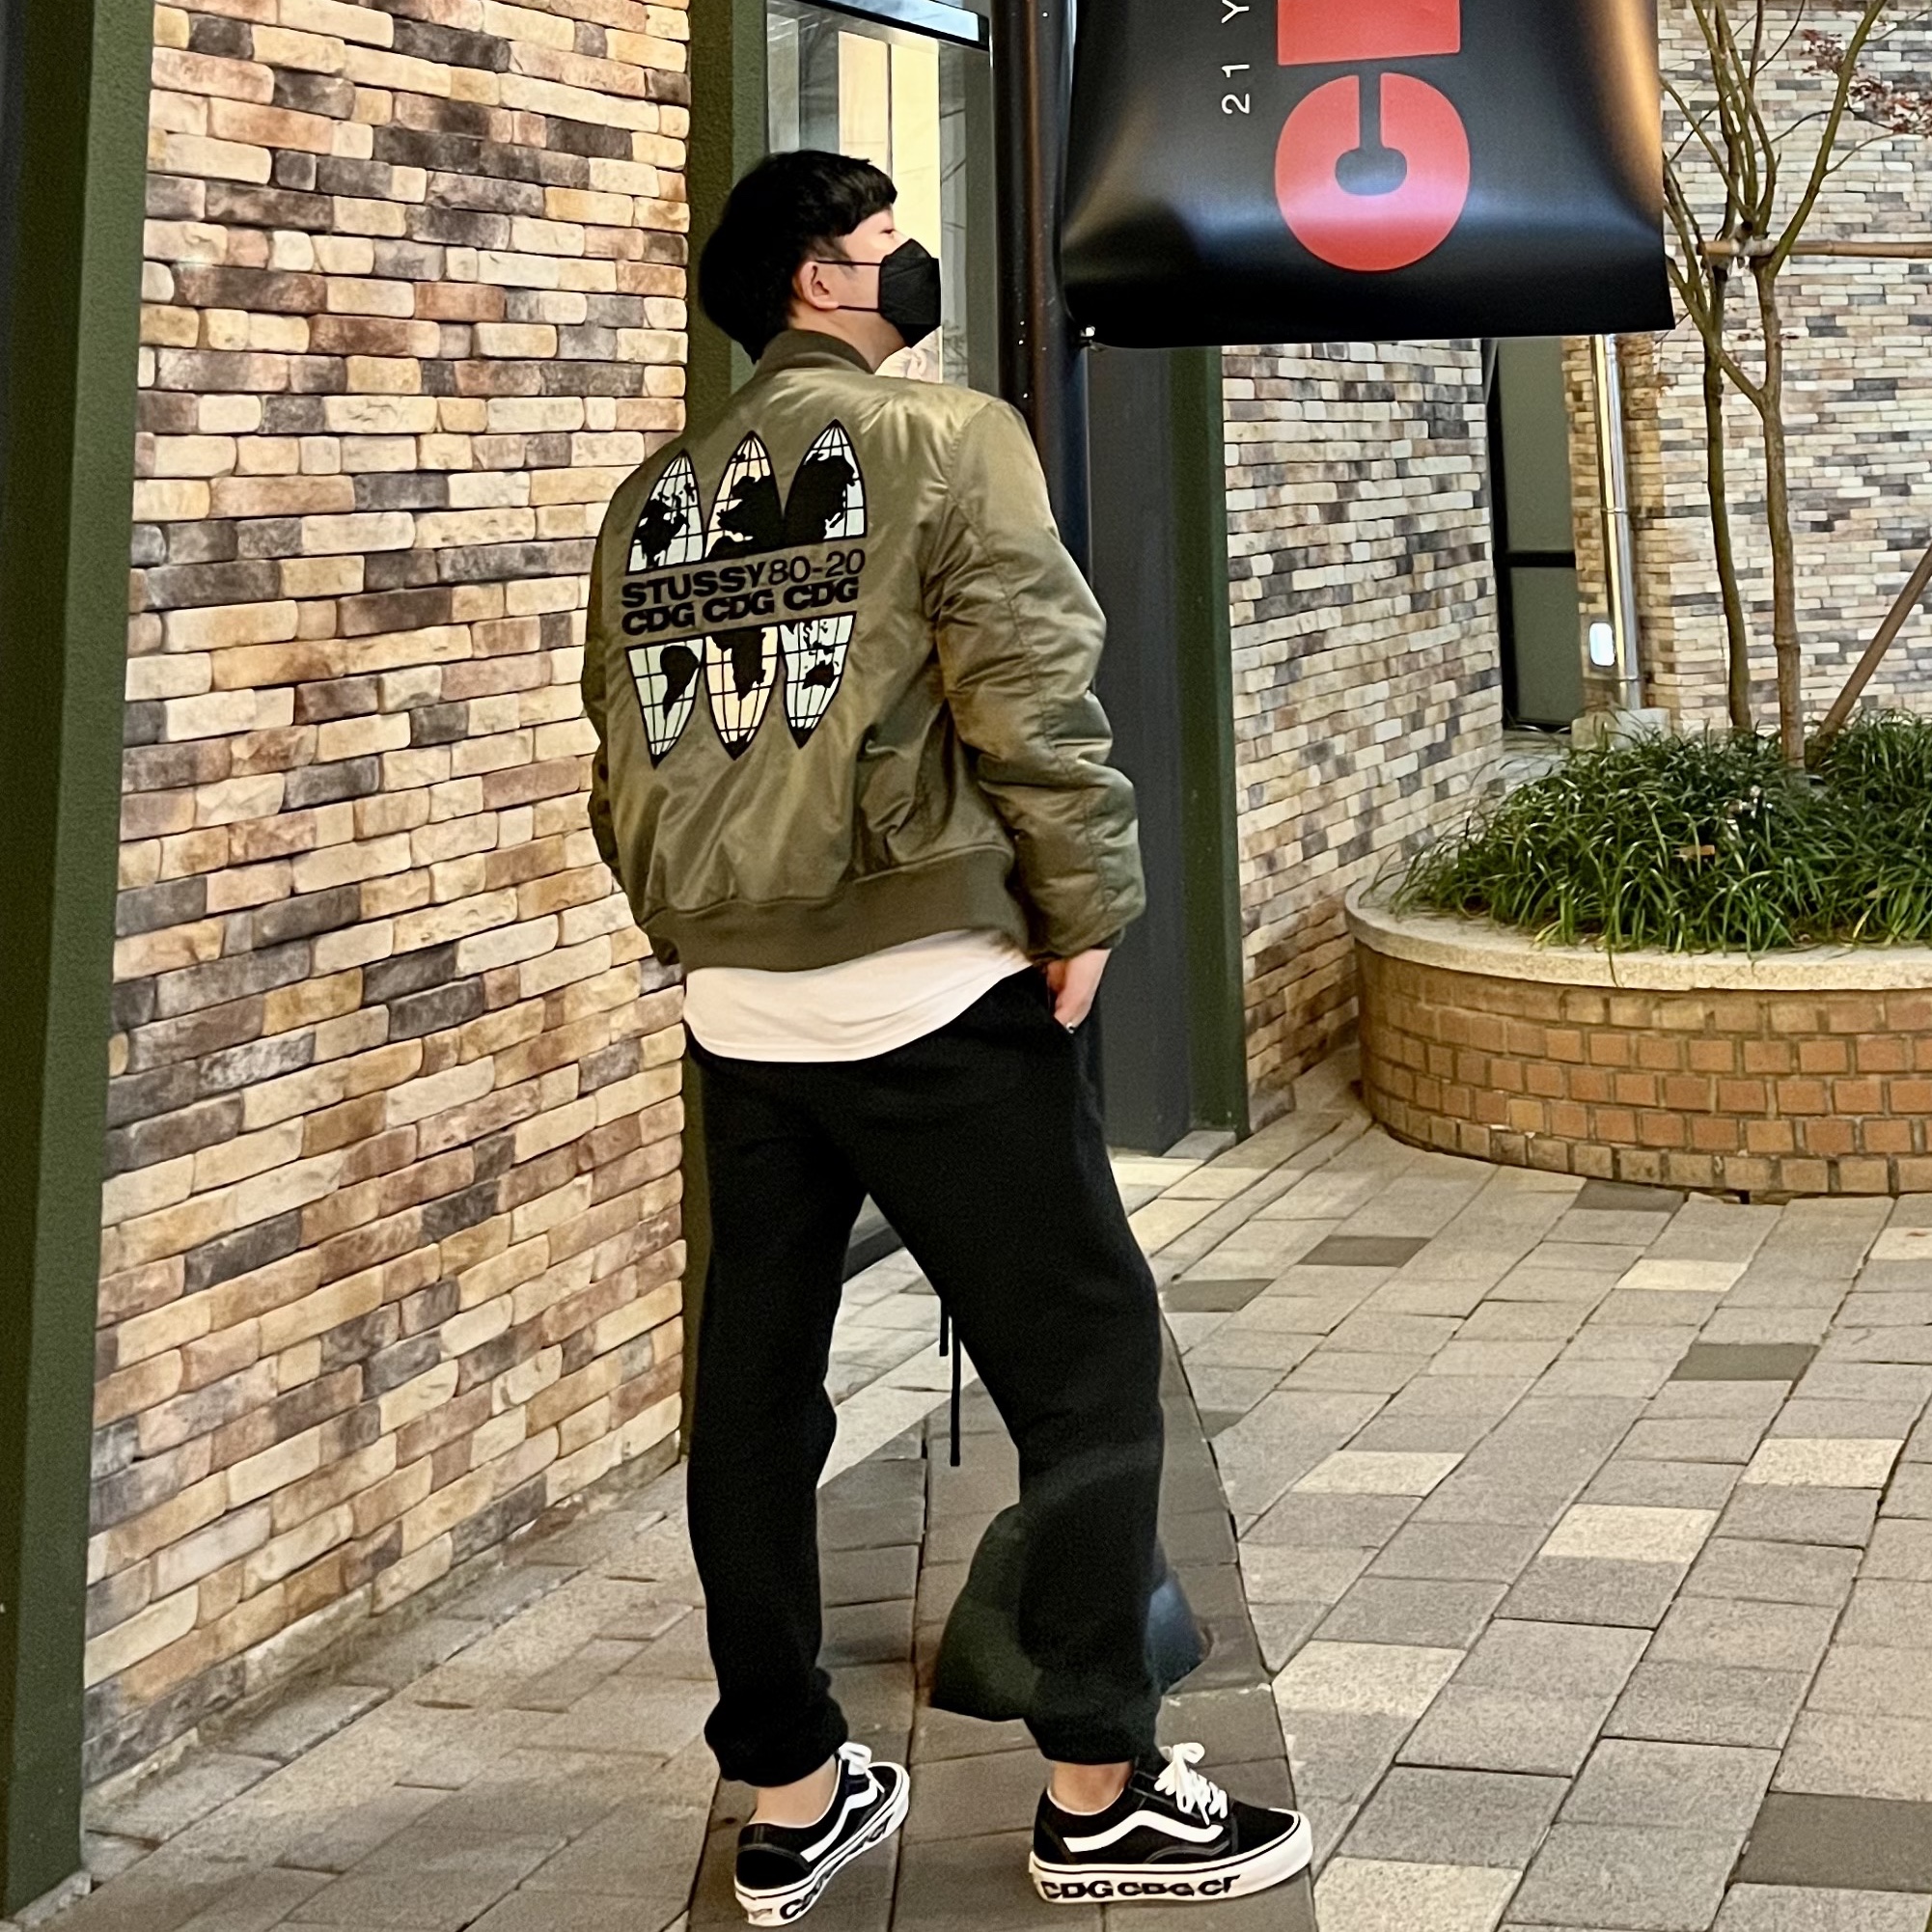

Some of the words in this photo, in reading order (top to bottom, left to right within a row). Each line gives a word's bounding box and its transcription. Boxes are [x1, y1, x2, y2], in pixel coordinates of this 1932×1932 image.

[621, 561, 766, 608] STUSSY
[768, 548, 866, 584] 80-20
[621, 603, 696, 636] CDG
[702, 590, 775, 623] CDG
[783, 577, 859, 611] CDG
